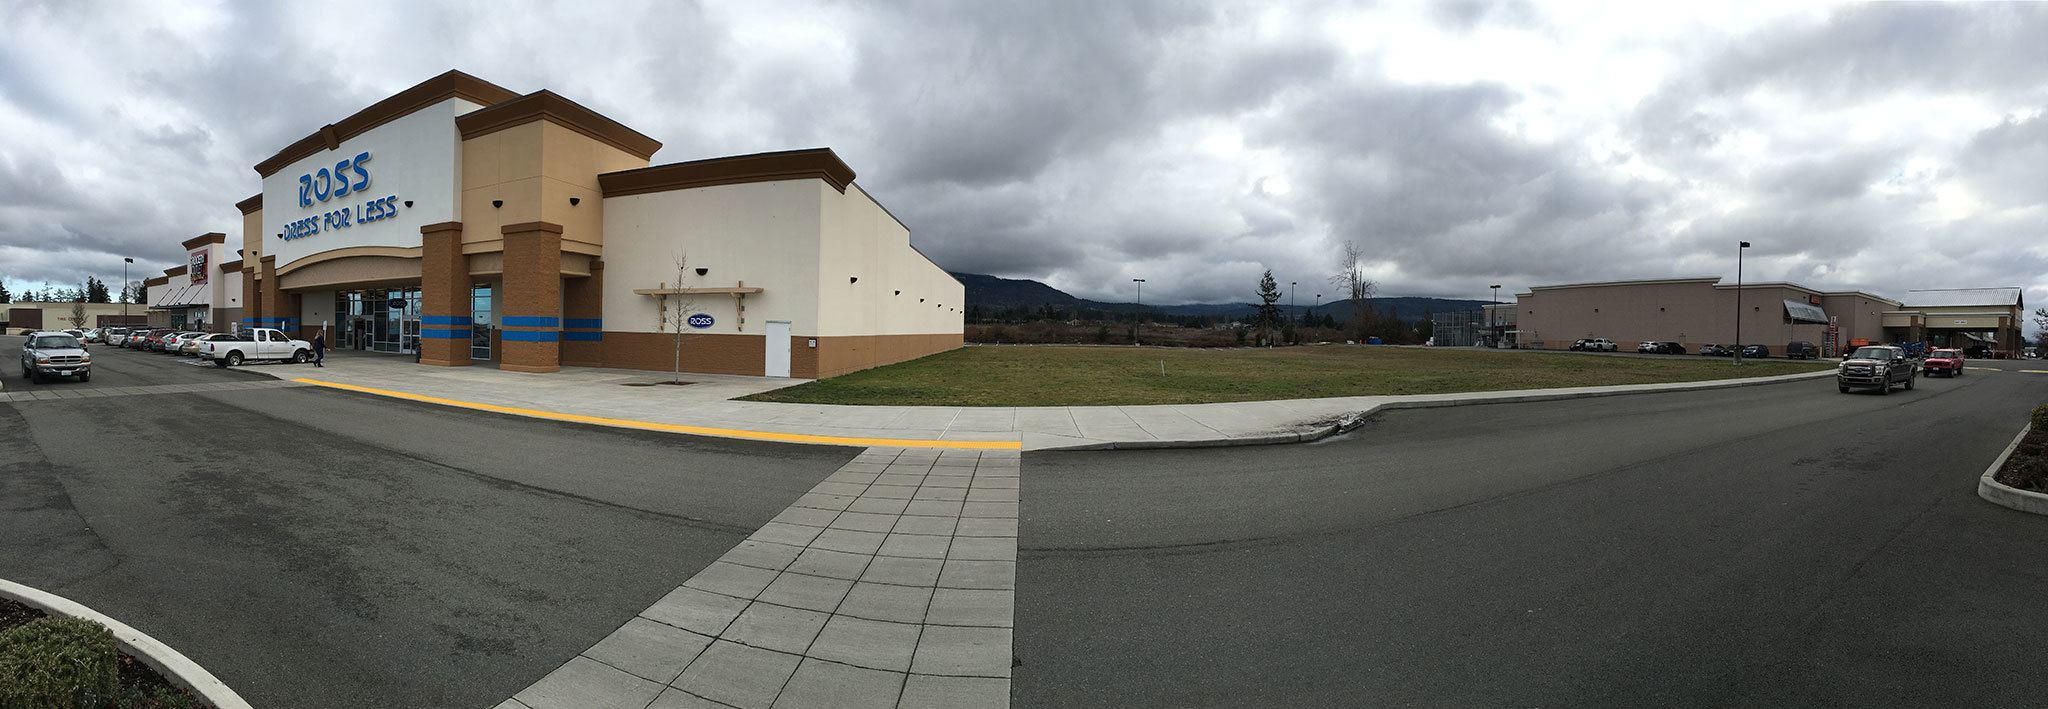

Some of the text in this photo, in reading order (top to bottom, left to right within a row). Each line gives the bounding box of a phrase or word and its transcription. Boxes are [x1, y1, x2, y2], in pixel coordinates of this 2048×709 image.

[299, 151, 372, 208] ROSS
[283, 195, 398, 242] DRESS FOR LESS
[690, 317, 712, 325] ROSS
